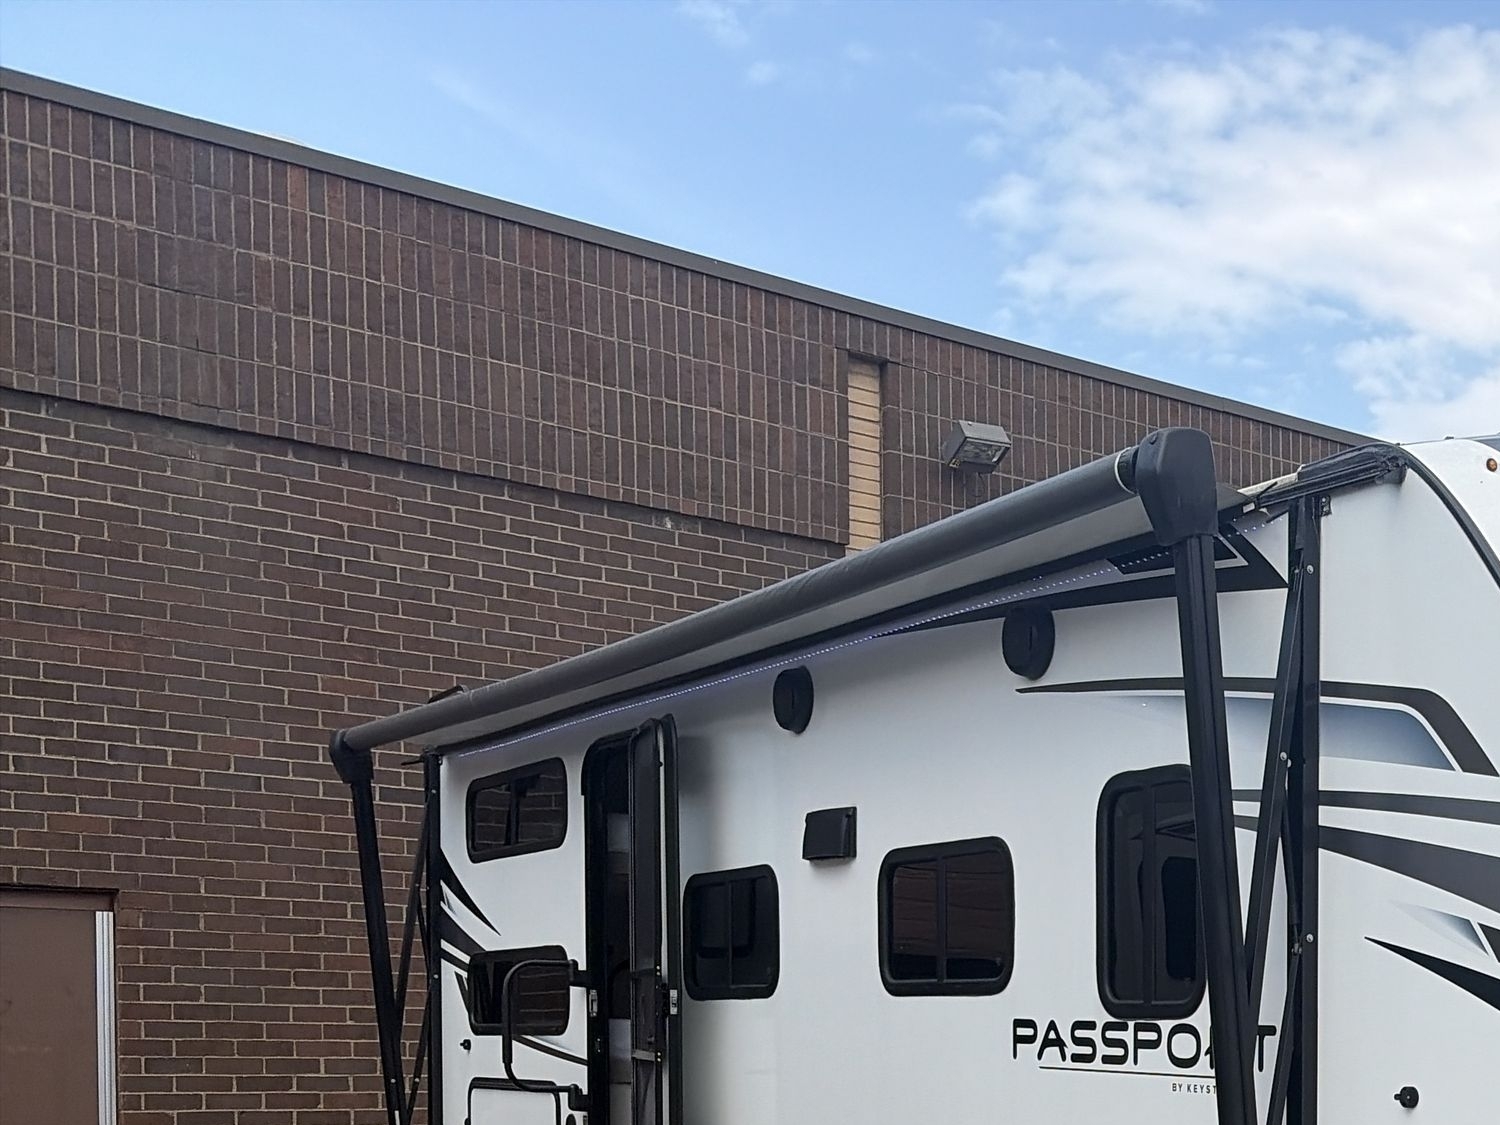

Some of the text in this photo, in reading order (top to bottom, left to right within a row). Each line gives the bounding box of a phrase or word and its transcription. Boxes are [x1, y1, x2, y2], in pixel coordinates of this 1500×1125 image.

[1012, 1018, 1277, 1073] PASSPOT
[1172, 1083, 1217, 1095] BY KEYST
